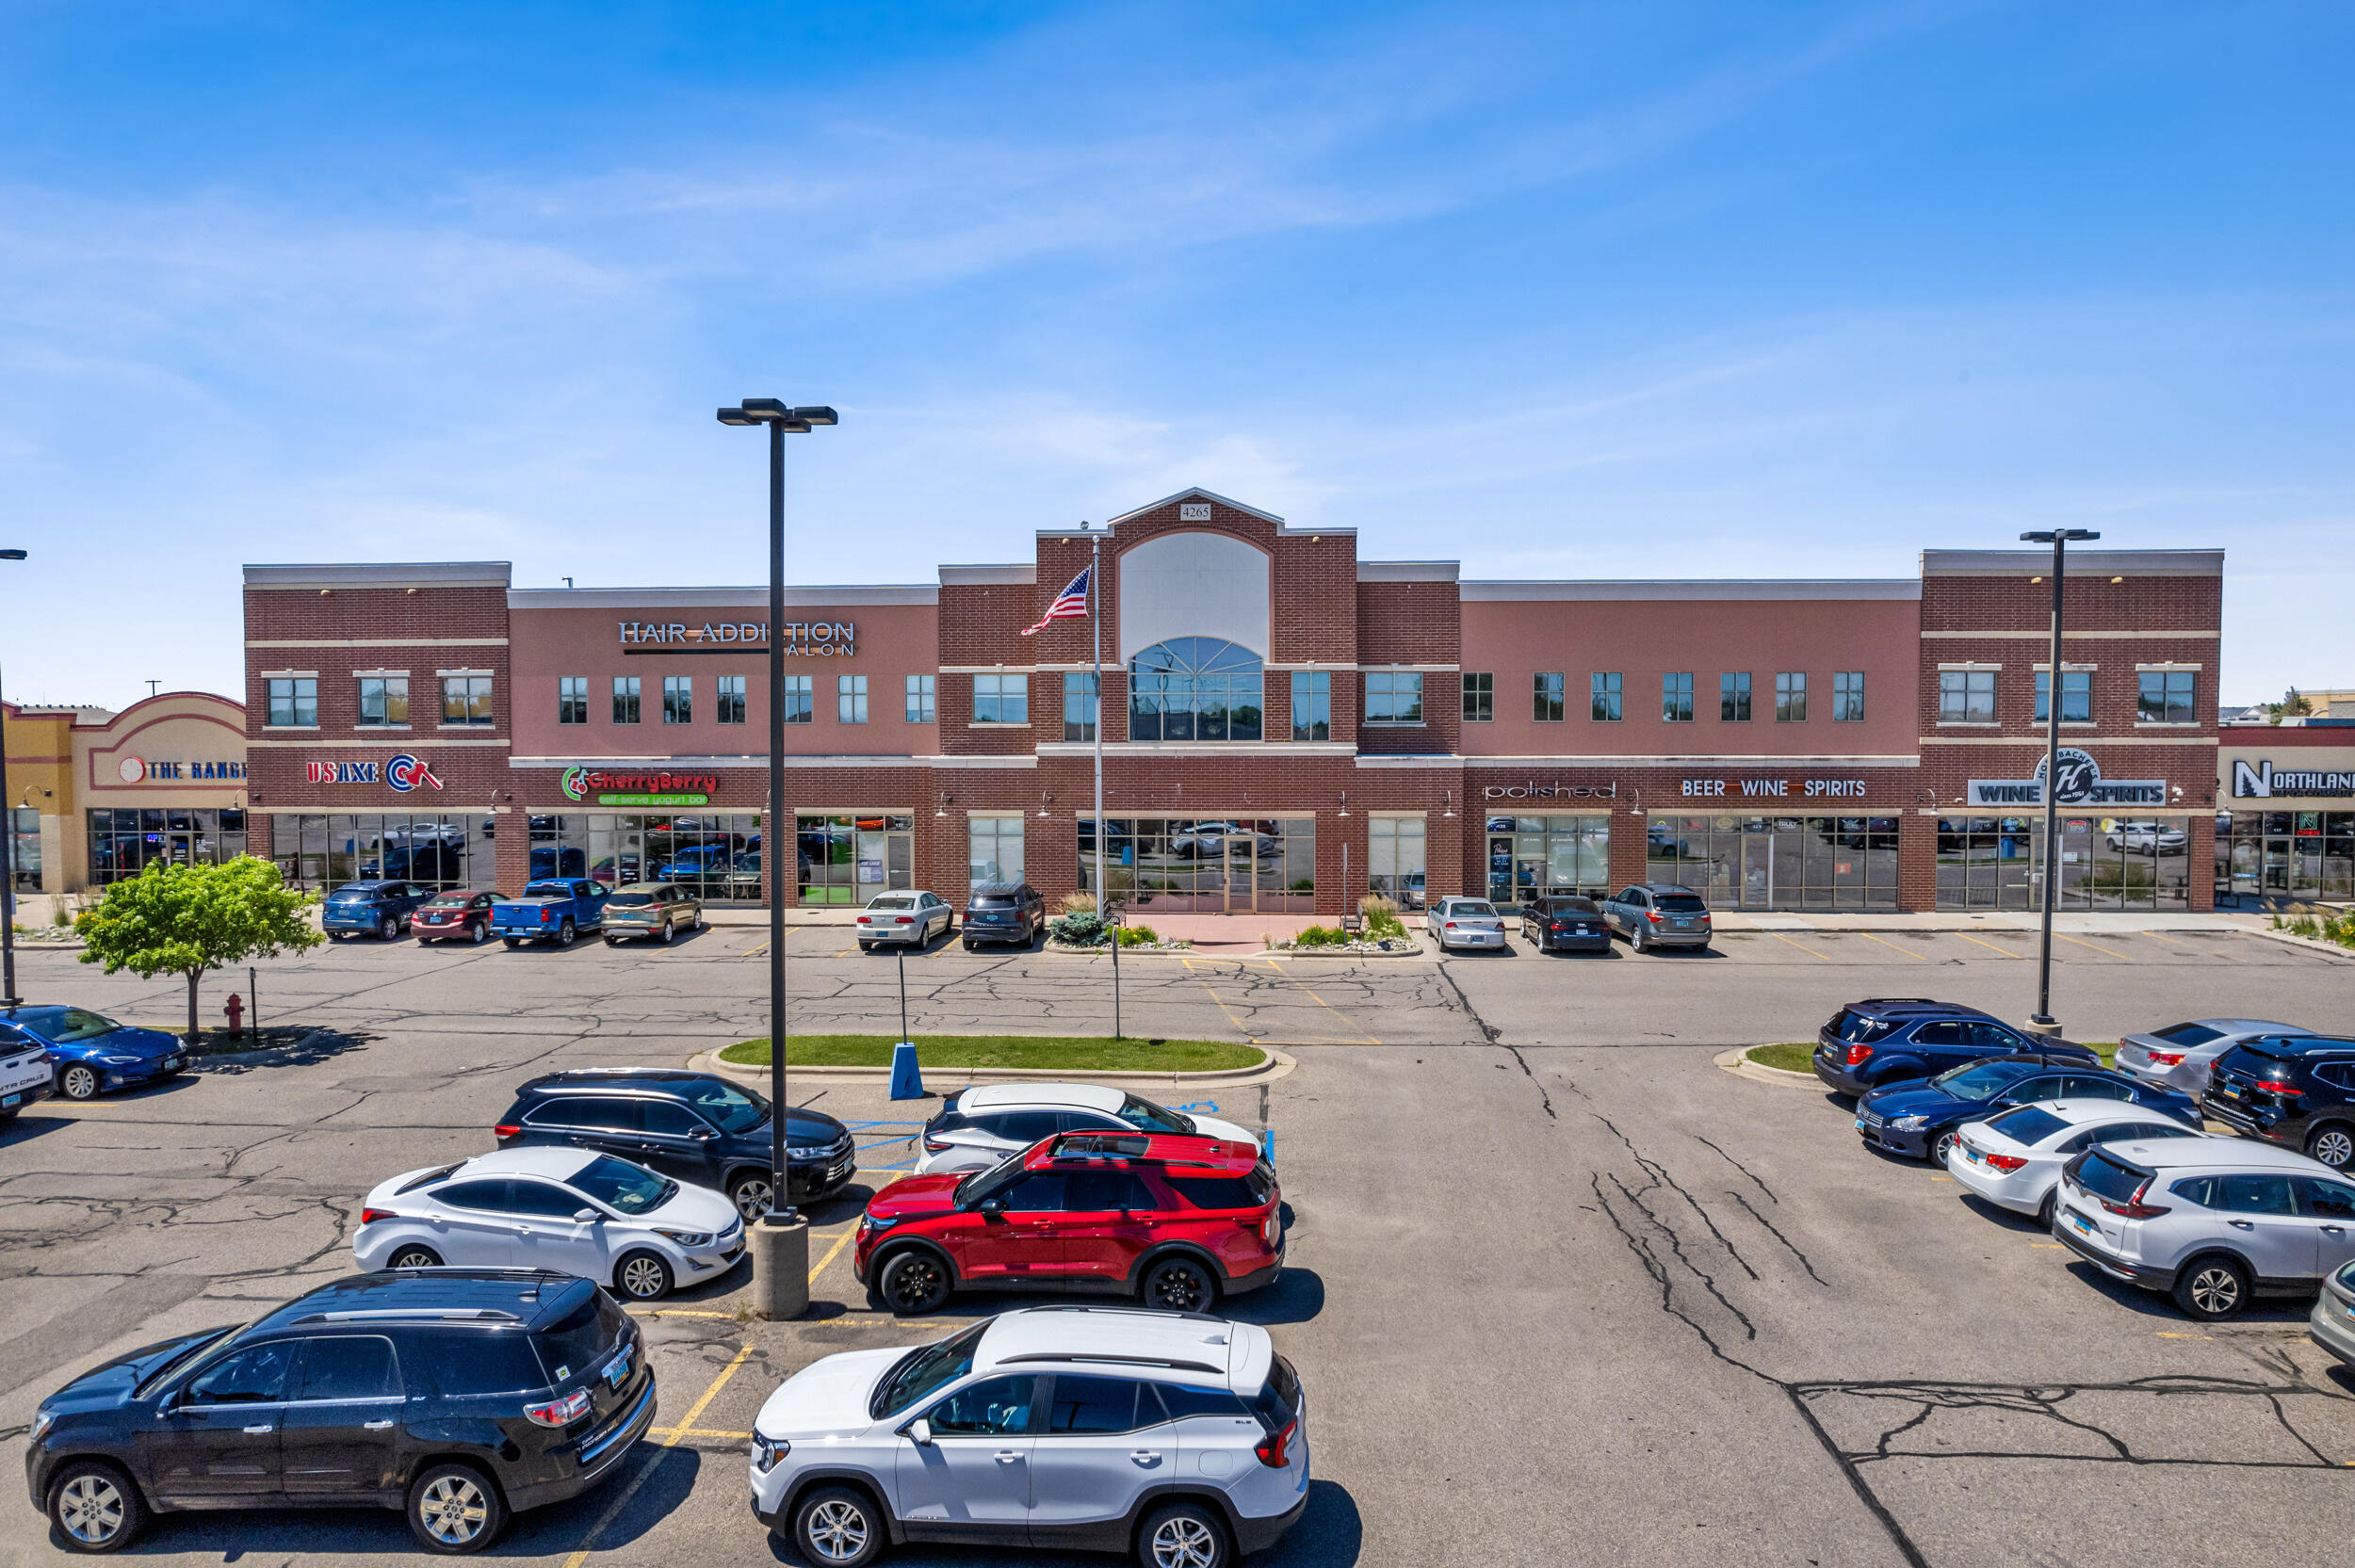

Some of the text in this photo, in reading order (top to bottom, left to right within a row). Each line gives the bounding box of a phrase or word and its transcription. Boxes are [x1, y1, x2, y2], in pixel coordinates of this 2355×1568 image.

[1183, 507, 1209, 517] 4265
[618, 622, 854, 642] HAIR ADDITION
[786, 644, 854, 656] ALON
[148, 762, 183, 779] THE
[2038, 750, 2098, 780] HOBACHER'S
[588, 772, 716, 793] CherryBerry
[2233, 760, 2355, 798] NORTHLAN
[1485, 780, 1616, 800] polished
[1682, 780, 1866, 797] BEER WINE SPIRITS
[1979, 785, 2164, 801] WINE SPIRITS
[601, 794, 706, 805] self-serve yogurt bar
[20, 1074, 44, 1085] CRUZ
